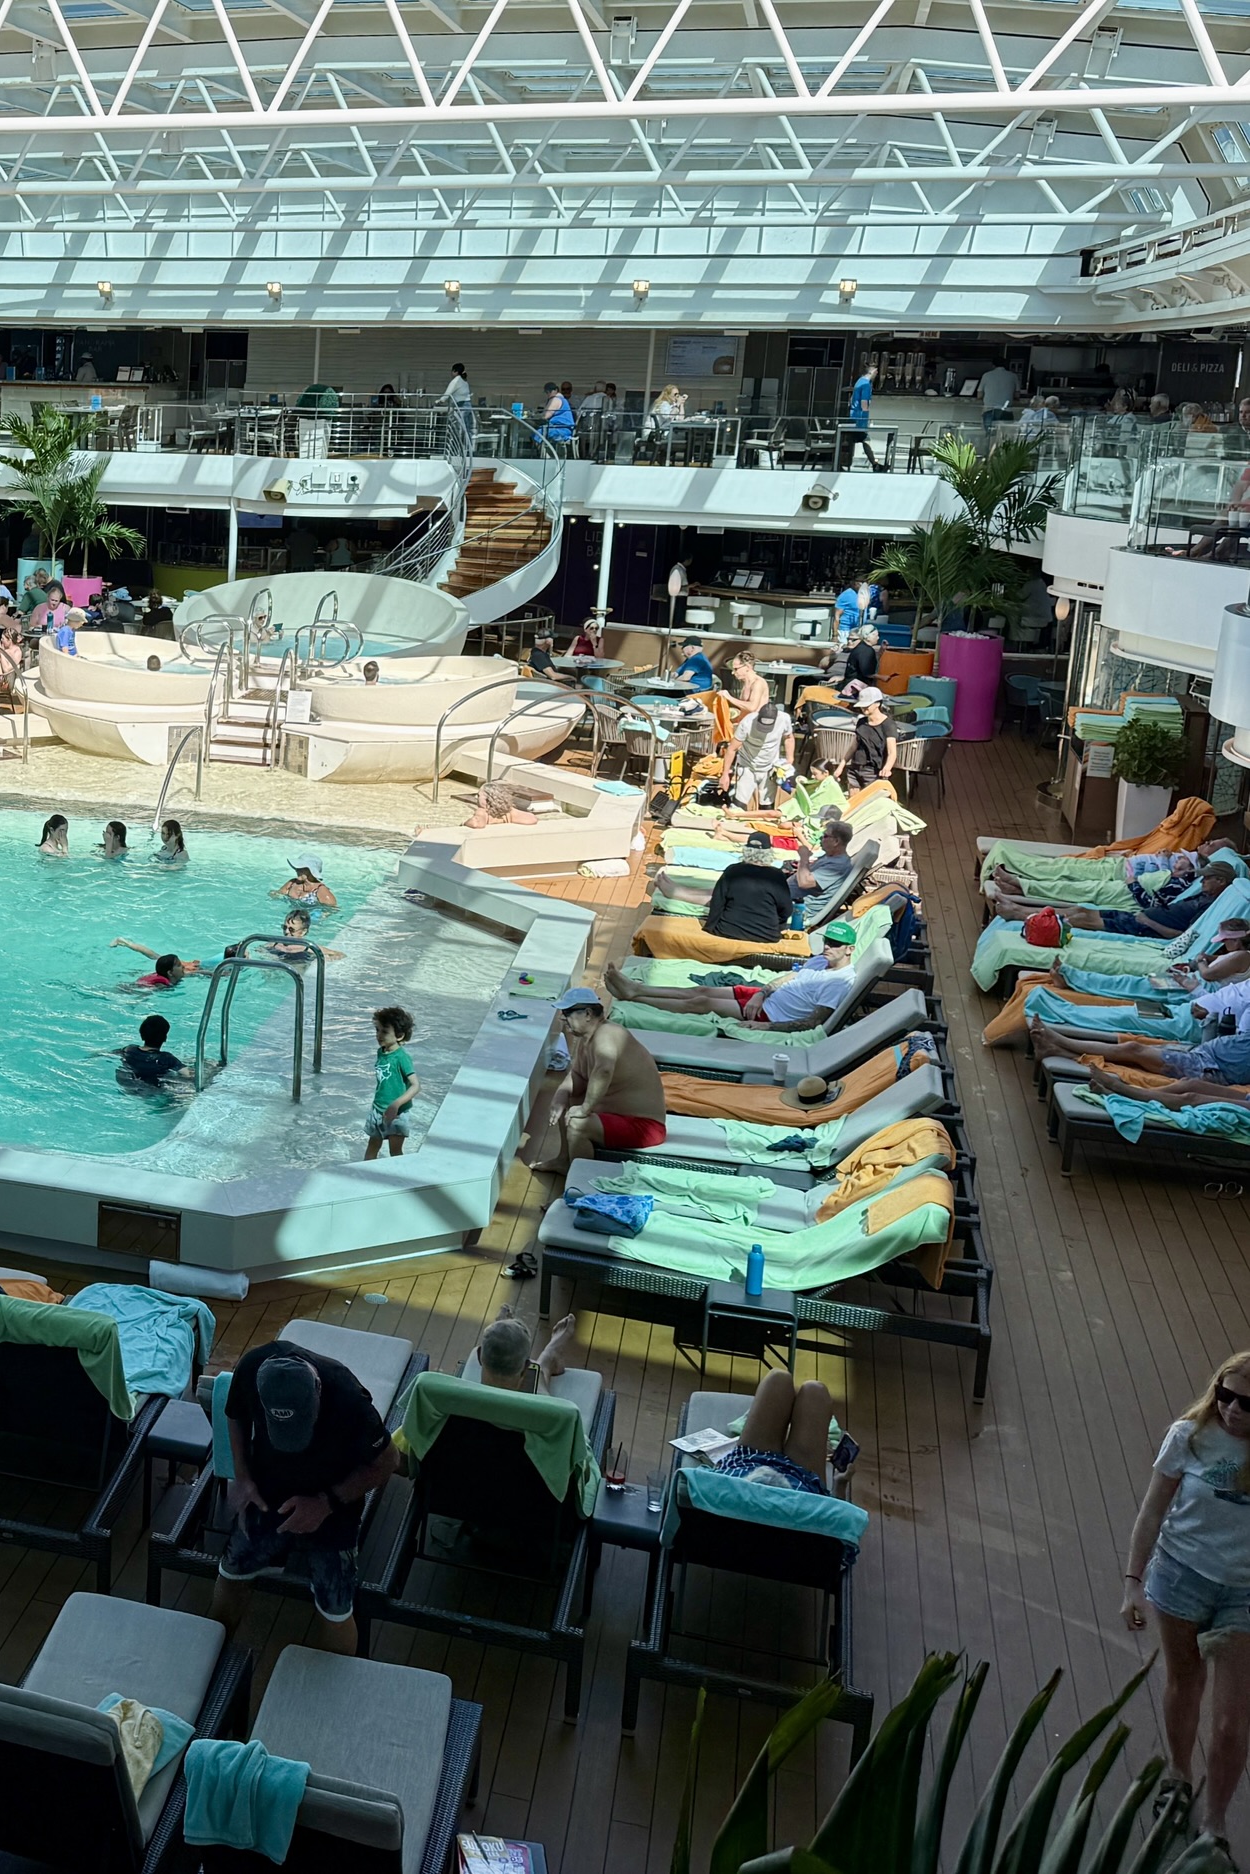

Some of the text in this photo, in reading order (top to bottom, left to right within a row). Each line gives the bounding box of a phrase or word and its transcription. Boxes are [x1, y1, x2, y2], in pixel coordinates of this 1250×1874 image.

[1171, 362, 1225, 373] DELI & PIZZA
[584, 530, 603, 543] LID
[586, 545, 601, 557] BA
